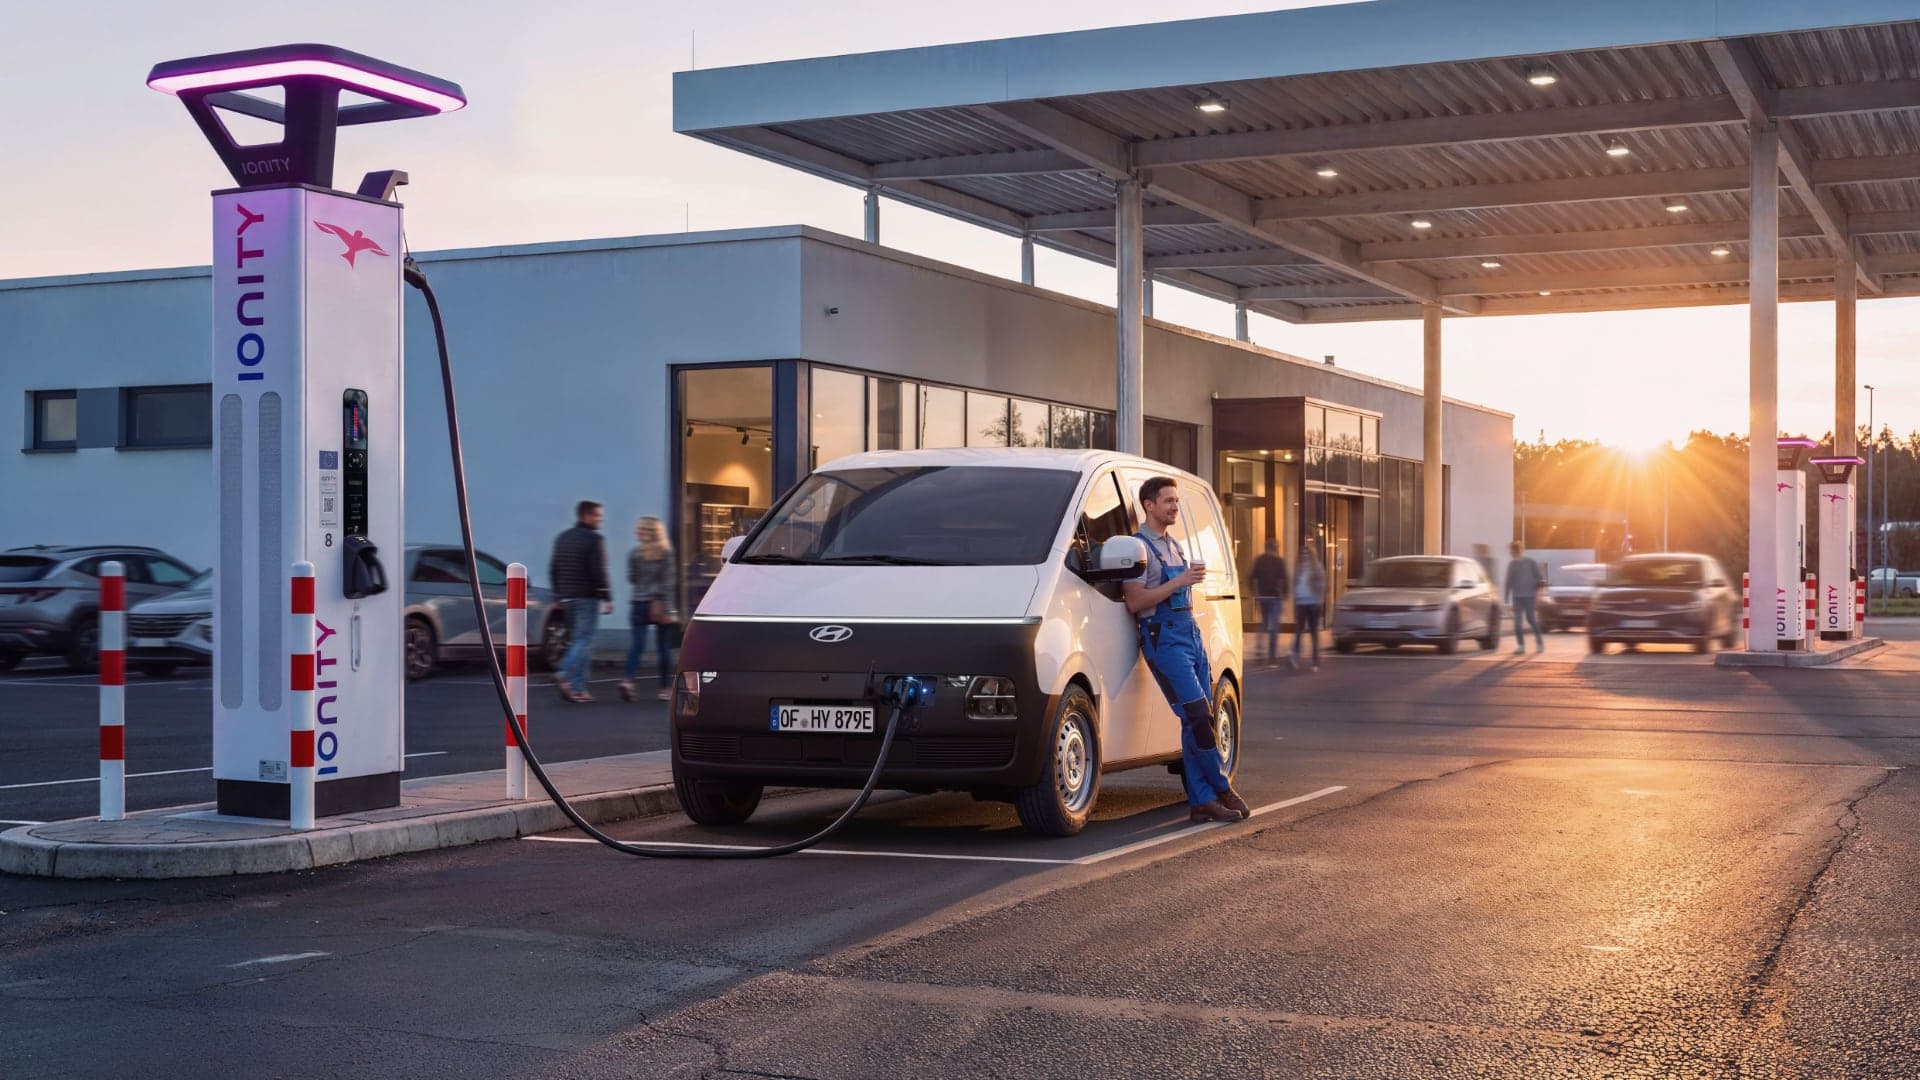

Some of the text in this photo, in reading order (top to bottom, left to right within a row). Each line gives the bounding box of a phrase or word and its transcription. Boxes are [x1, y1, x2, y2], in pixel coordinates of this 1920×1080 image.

[241, 157, 289, 175] IONITY
[236, 203, 264, 381] IONITY
[325, 533, 333, 547] 8
[1828, 584, 1838, 628] IONITY
[315, 619, 338, 775] IONITY
[780, 708, 872, 730] OF HY 879E
